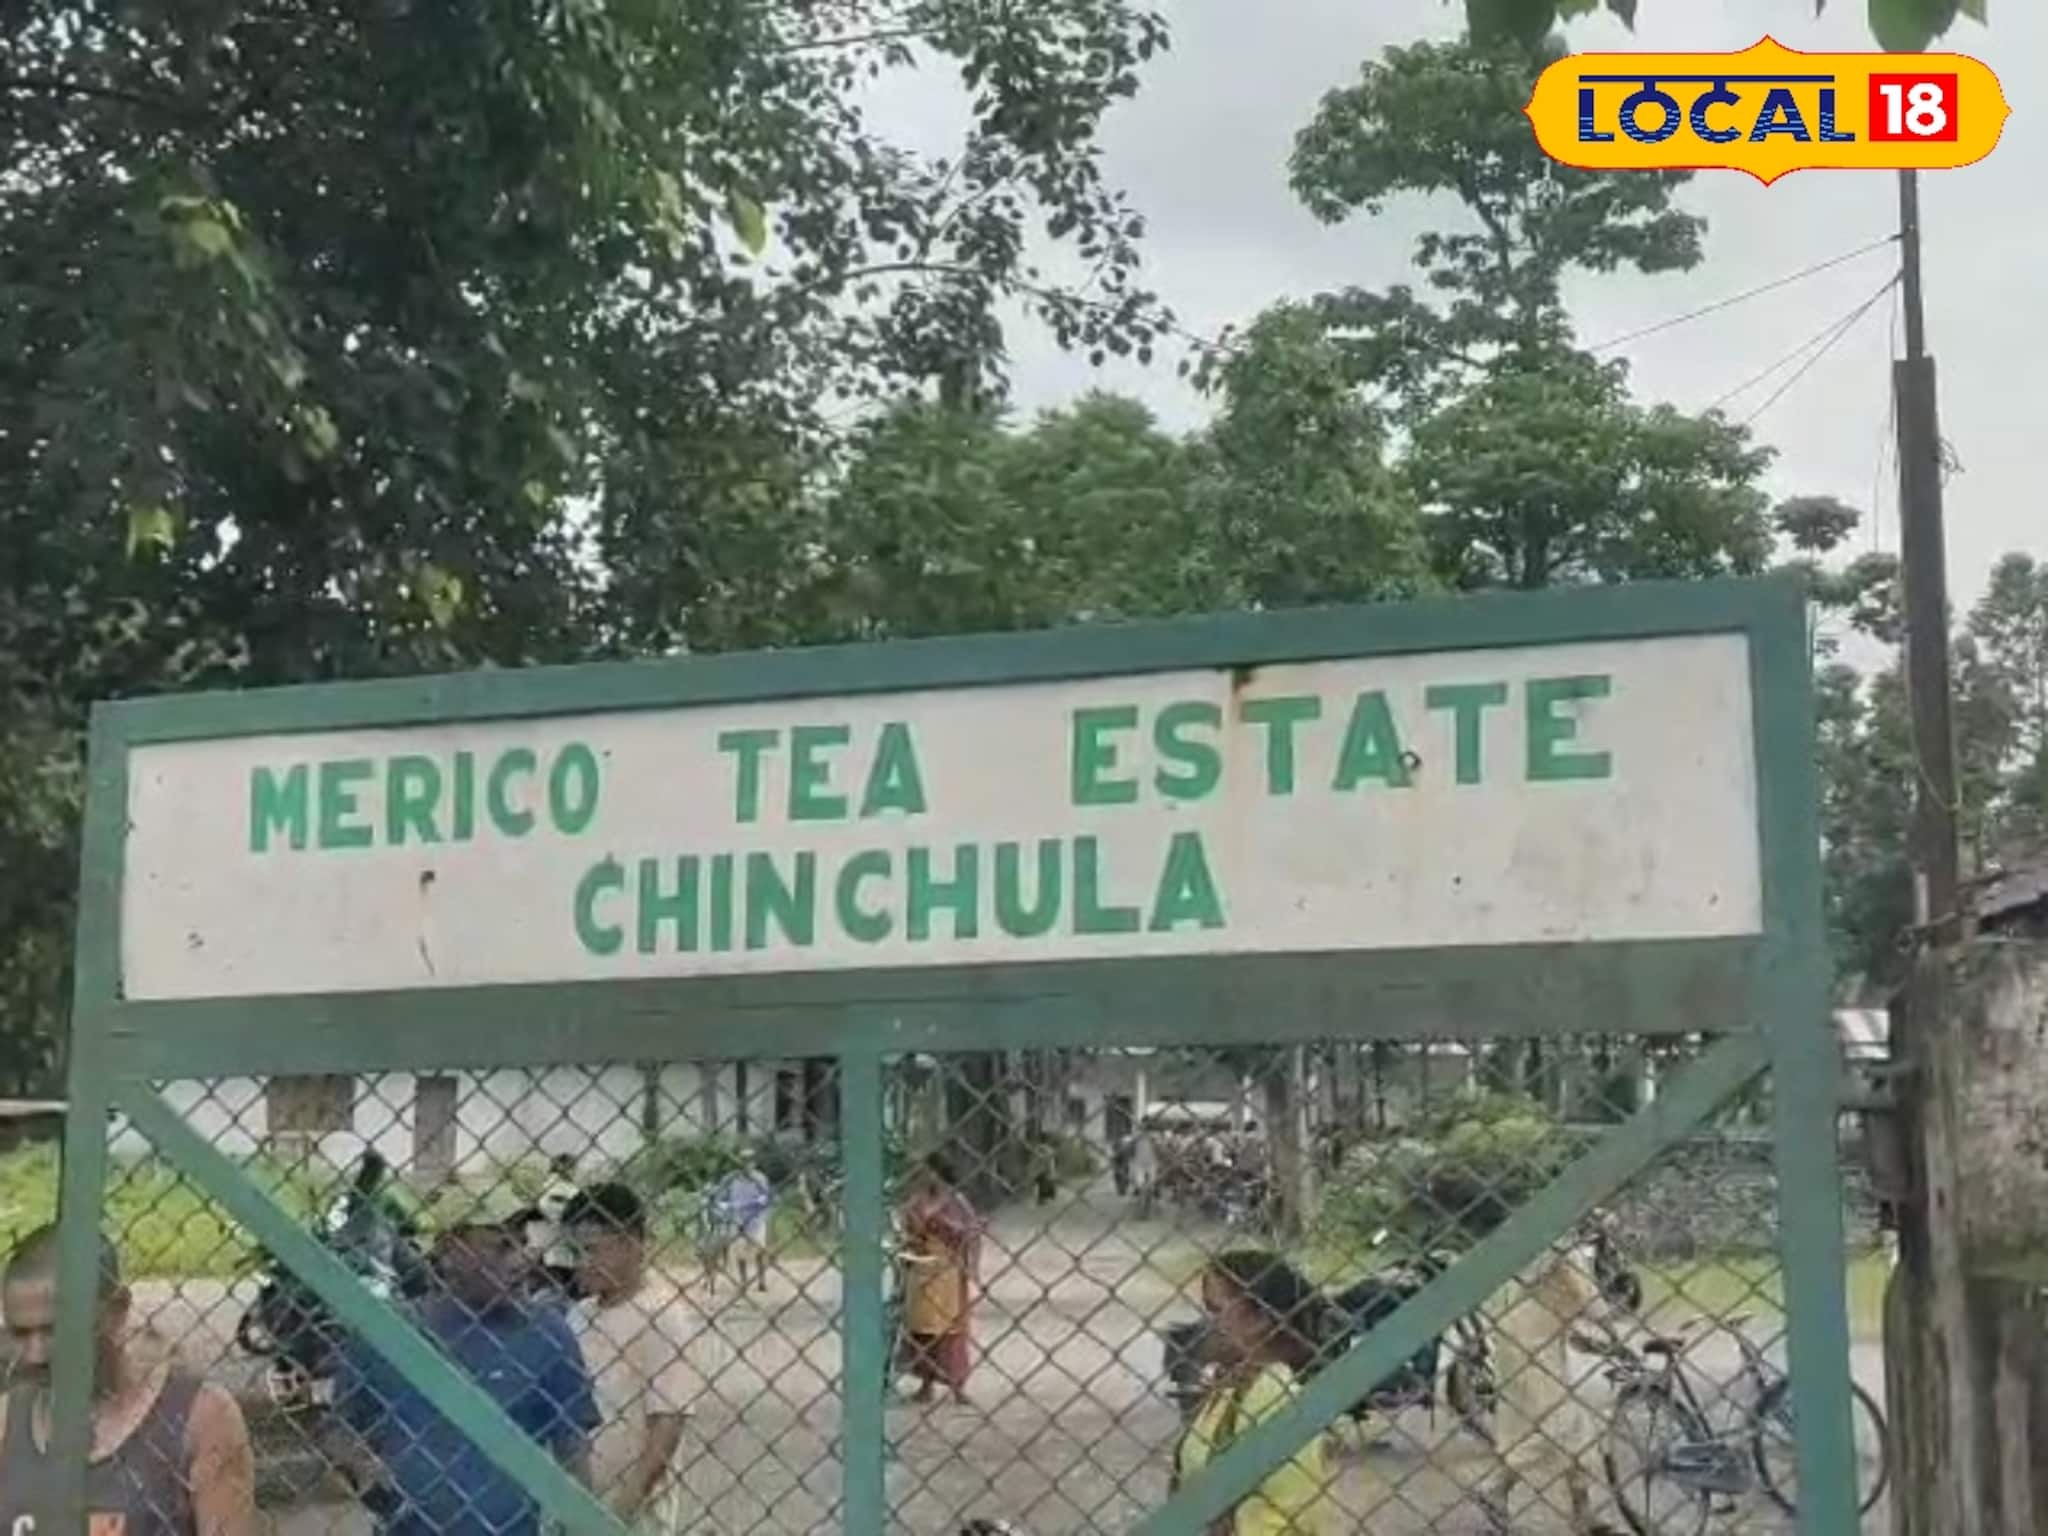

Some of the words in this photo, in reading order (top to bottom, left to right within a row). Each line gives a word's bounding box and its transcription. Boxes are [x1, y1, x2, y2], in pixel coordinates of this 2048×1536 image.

[249, 742, 600, 853] MERICO
[718, 725, 926, 825] TEA
[1070, 675, 1613, 808] ESTATE
[573, 833, 1227, 957] CHINCHULA
